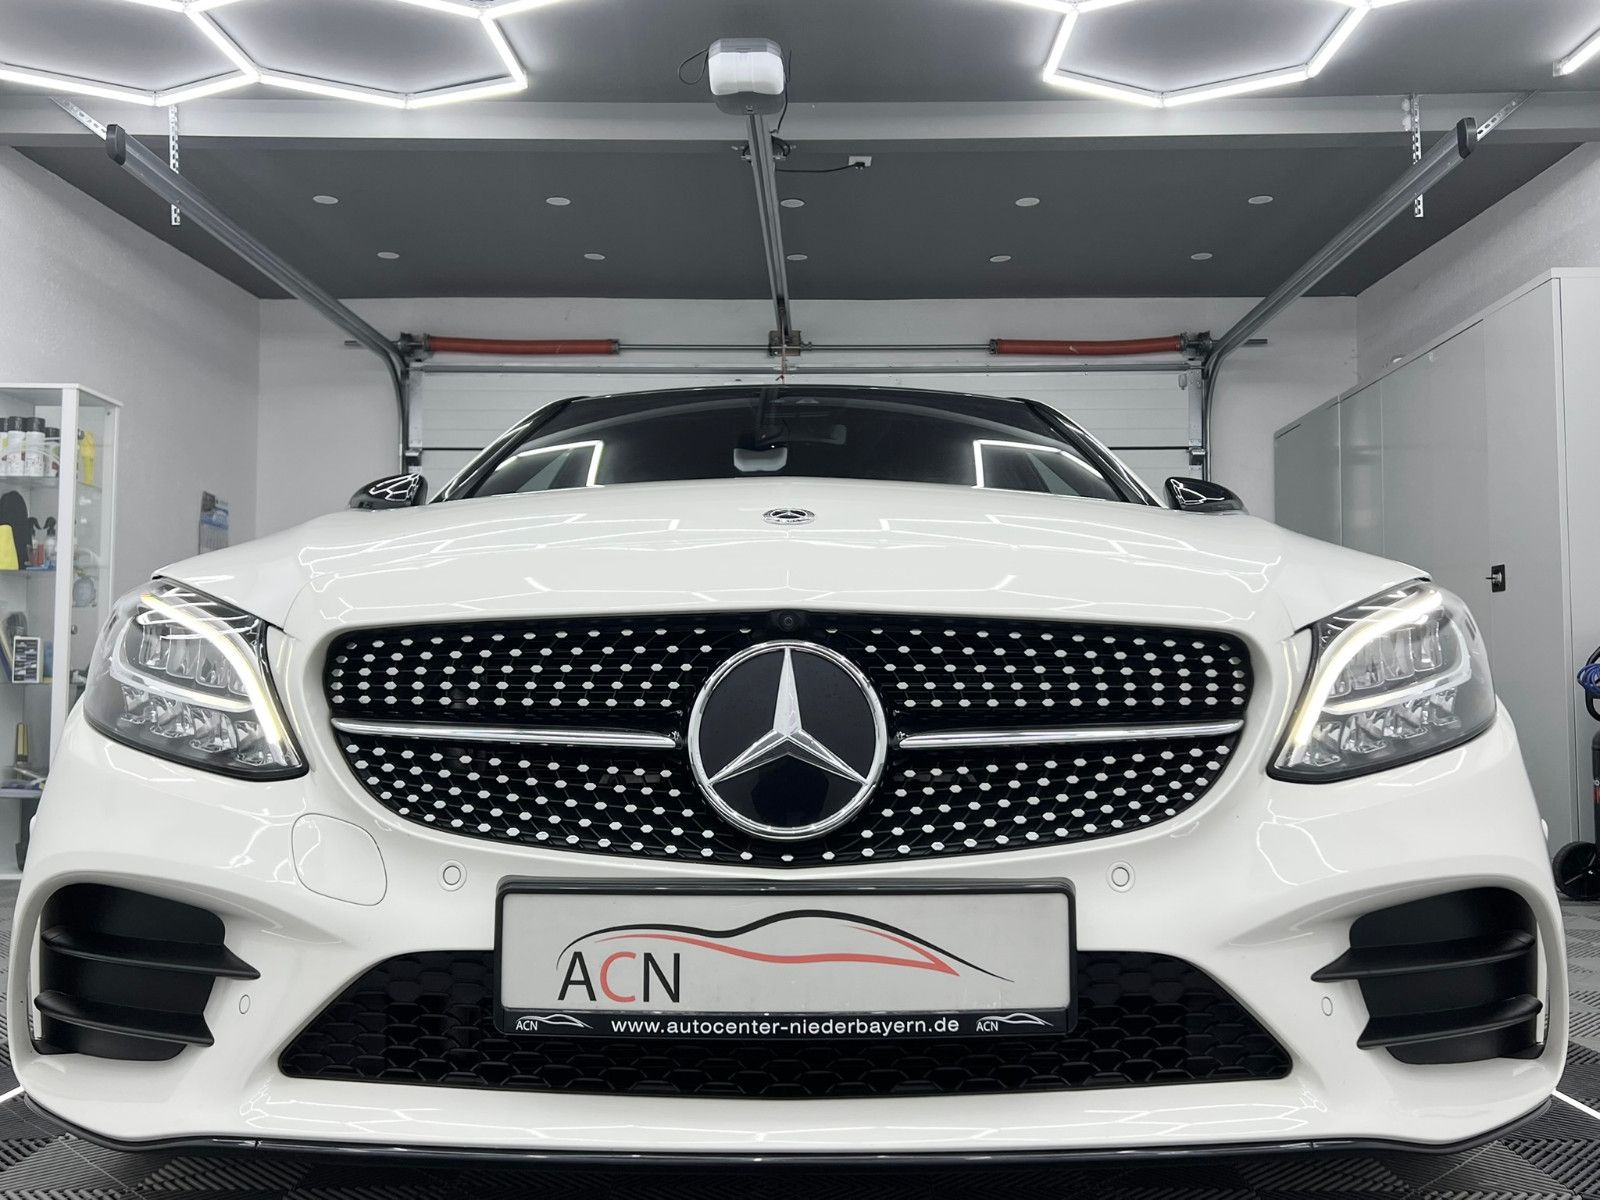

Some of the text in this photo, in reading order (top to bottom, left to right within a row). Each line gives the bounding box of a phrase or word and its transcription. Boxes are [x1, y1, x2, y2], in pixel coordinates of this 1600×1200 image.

[557, 951, 680, 1003] ACN
[515, 1020, 538, 1031] ACN
[611, 1017, 960, 1036] www.autocenter-niederbayern.de
[976, 1020, 999, 1032] ACN
